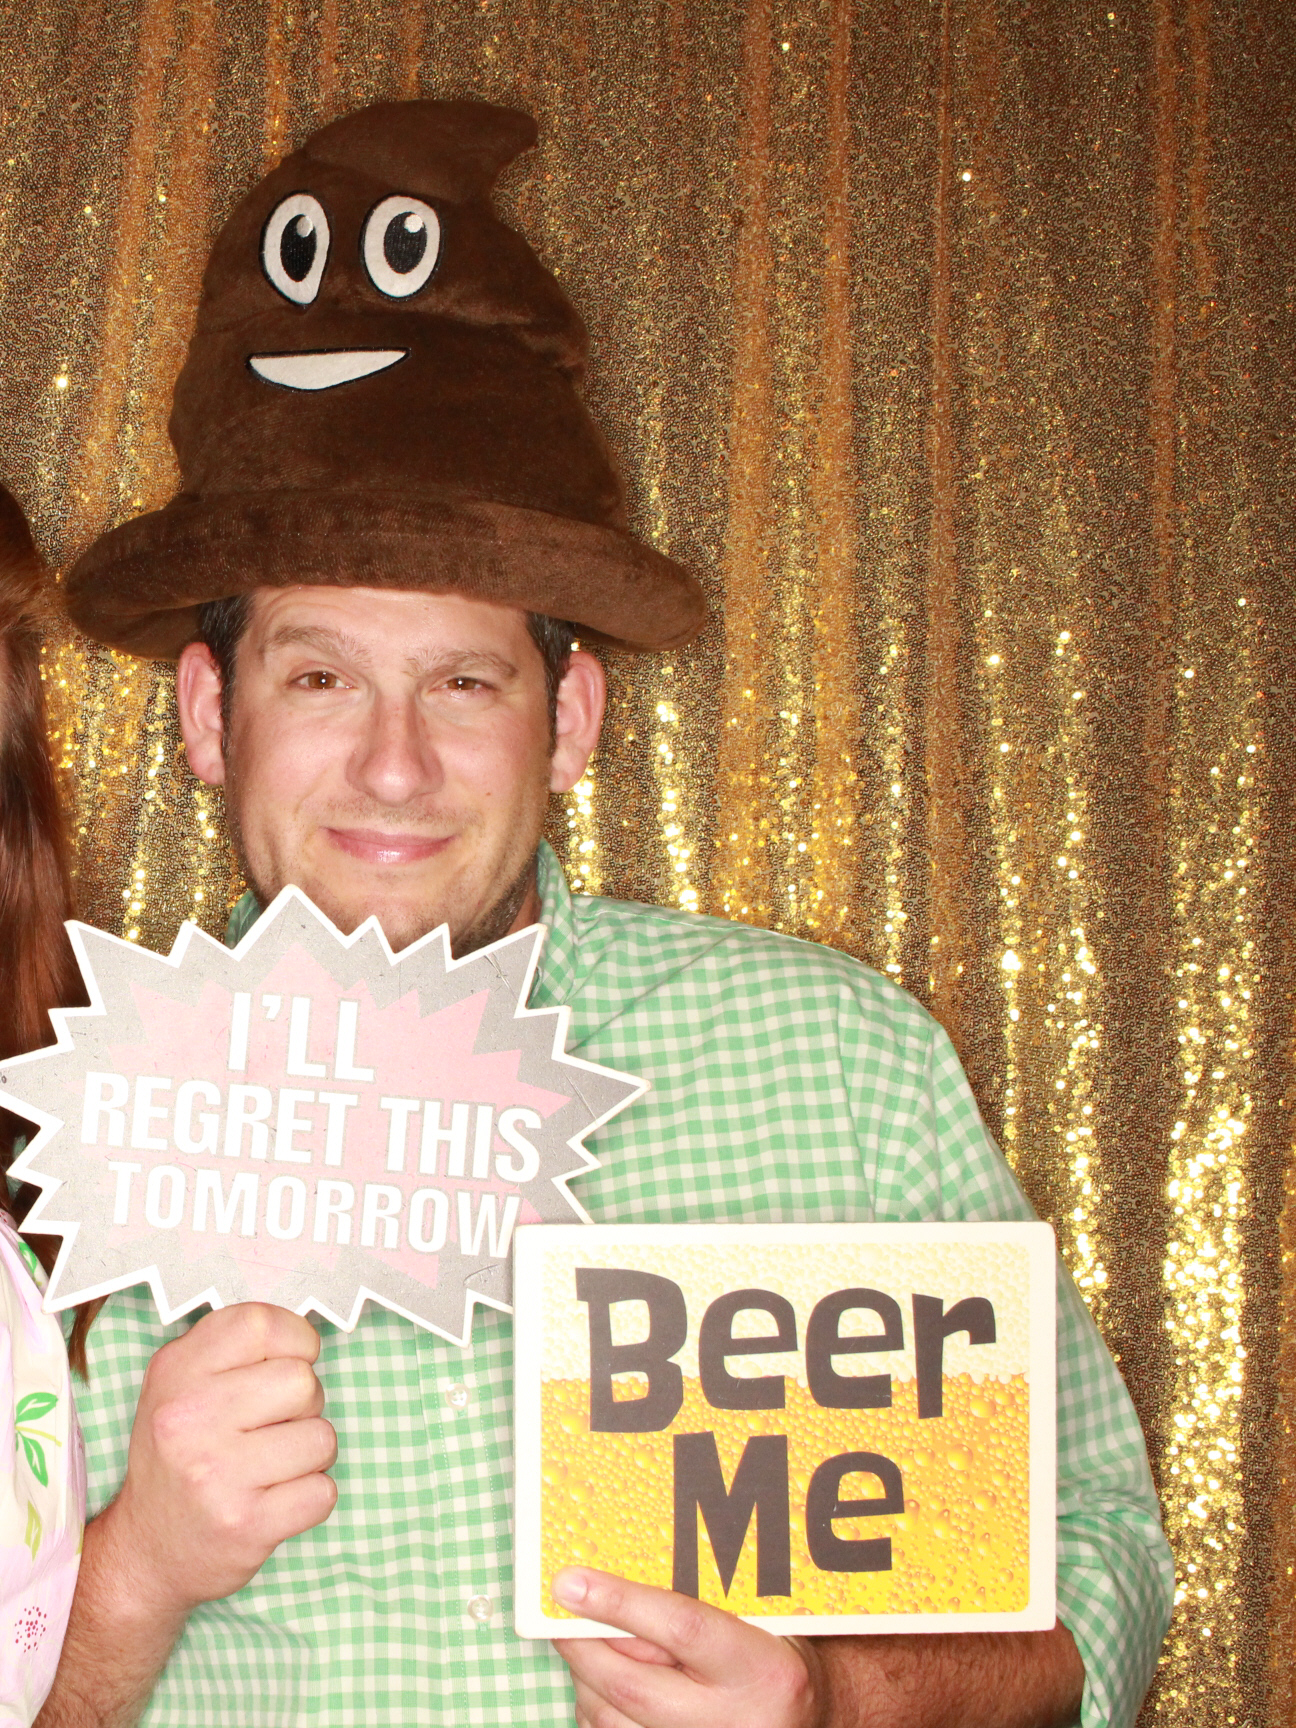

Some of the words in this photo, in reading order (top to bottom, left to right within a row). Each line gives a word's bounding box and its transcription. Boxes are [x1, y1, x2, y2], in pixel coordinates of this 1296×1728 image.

[227, 992, 375, 1082] I'LL
[81, 1071, 360, 1167] REGRET
[380, 1098, 542, 1183] THIS
[108, 1161, 521, 1258] TOMORROW
[575, 1267, 997, 1433] Beer
[672, 1431, 905, 1600] Me
